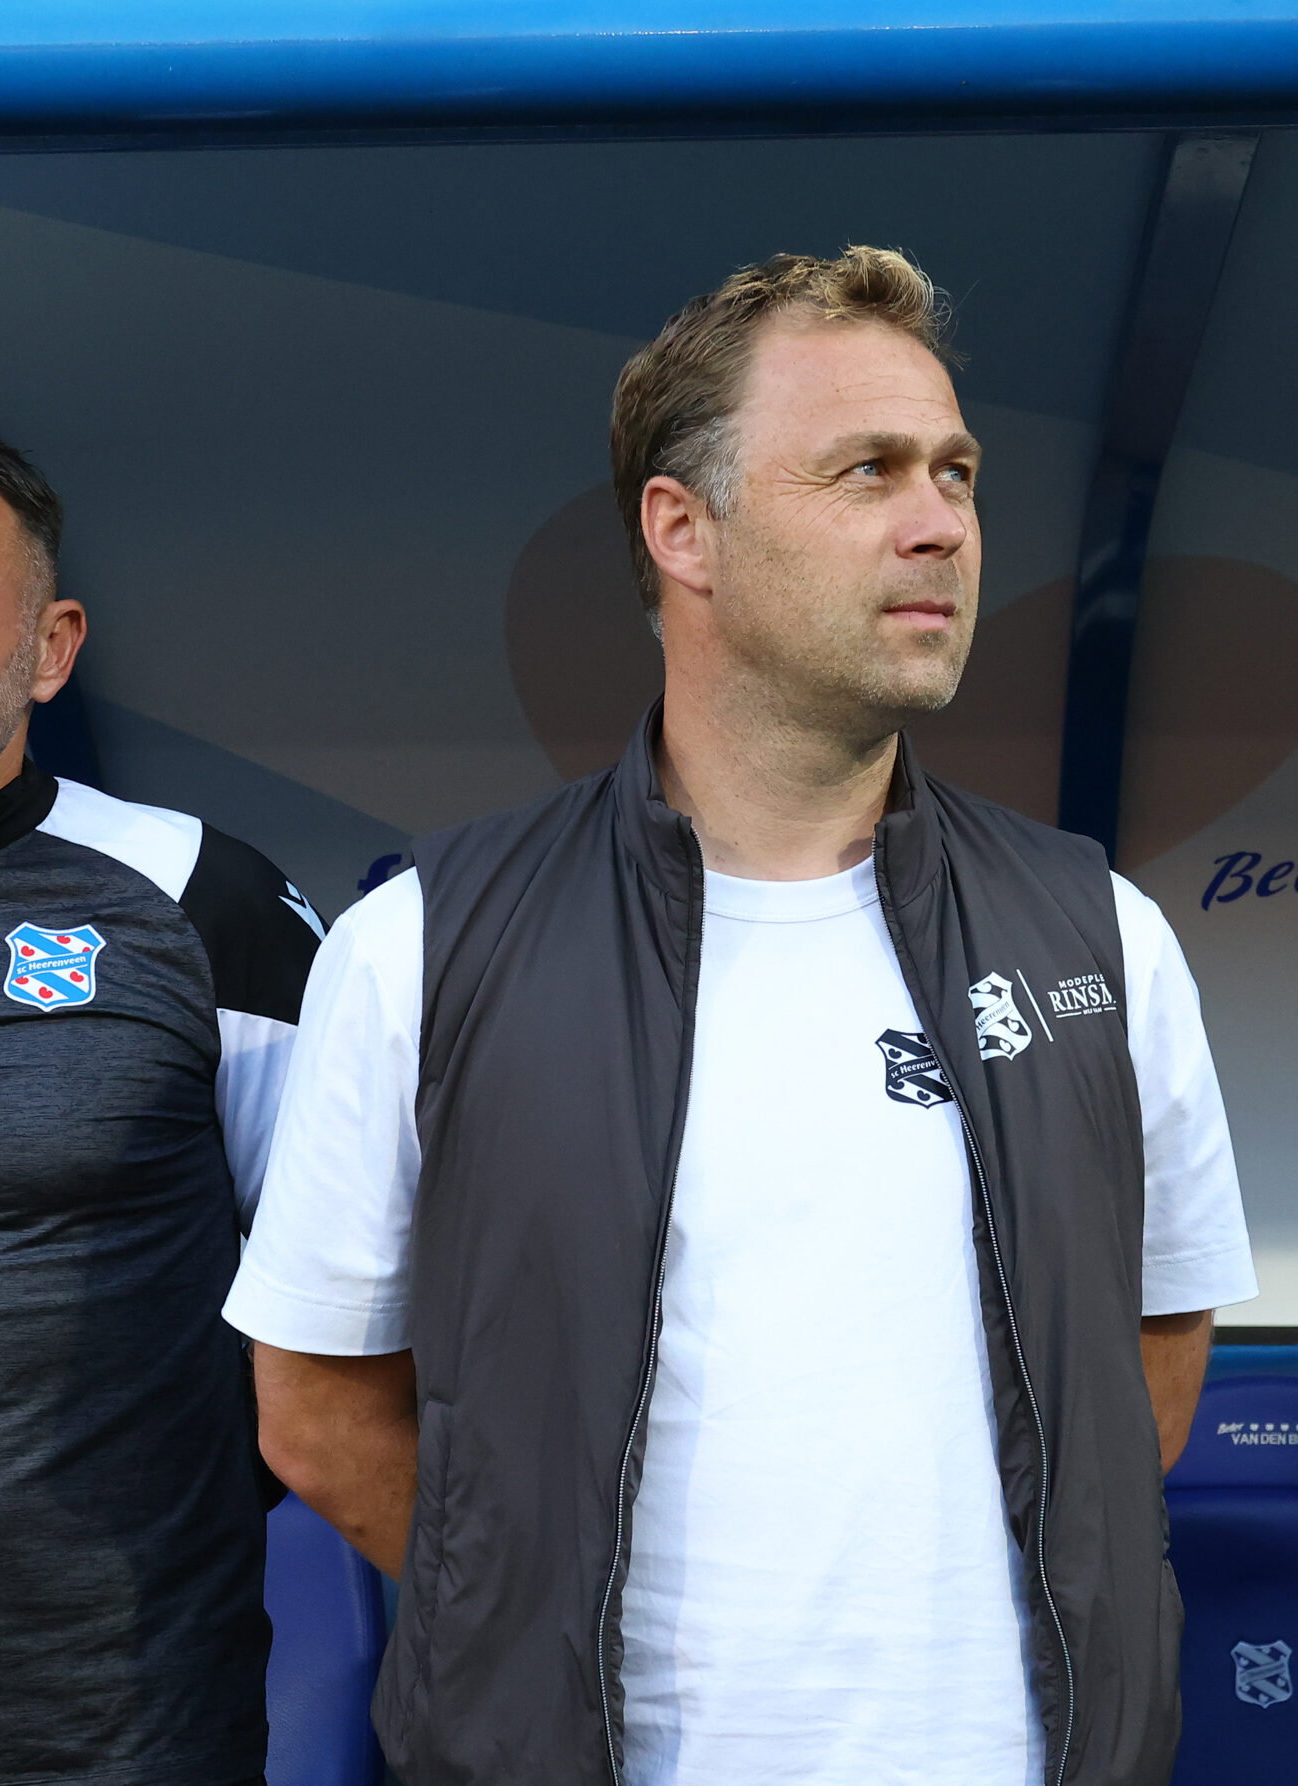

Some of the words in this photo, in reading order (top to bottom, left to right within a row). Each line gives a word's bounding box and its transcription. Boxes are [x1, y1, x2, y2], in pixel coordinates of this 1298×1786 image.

[1201, 851, 1298, 911] Be
[28, 956, 86, 970] Heerenveen
[1058, 973, 1105, 989] MODEPLE
[899, 1059, 936, 1075] Heerenv
[1231, 1433, 1259, 1446] VAN
[1260, 1433, 1287, 1446] DEN
